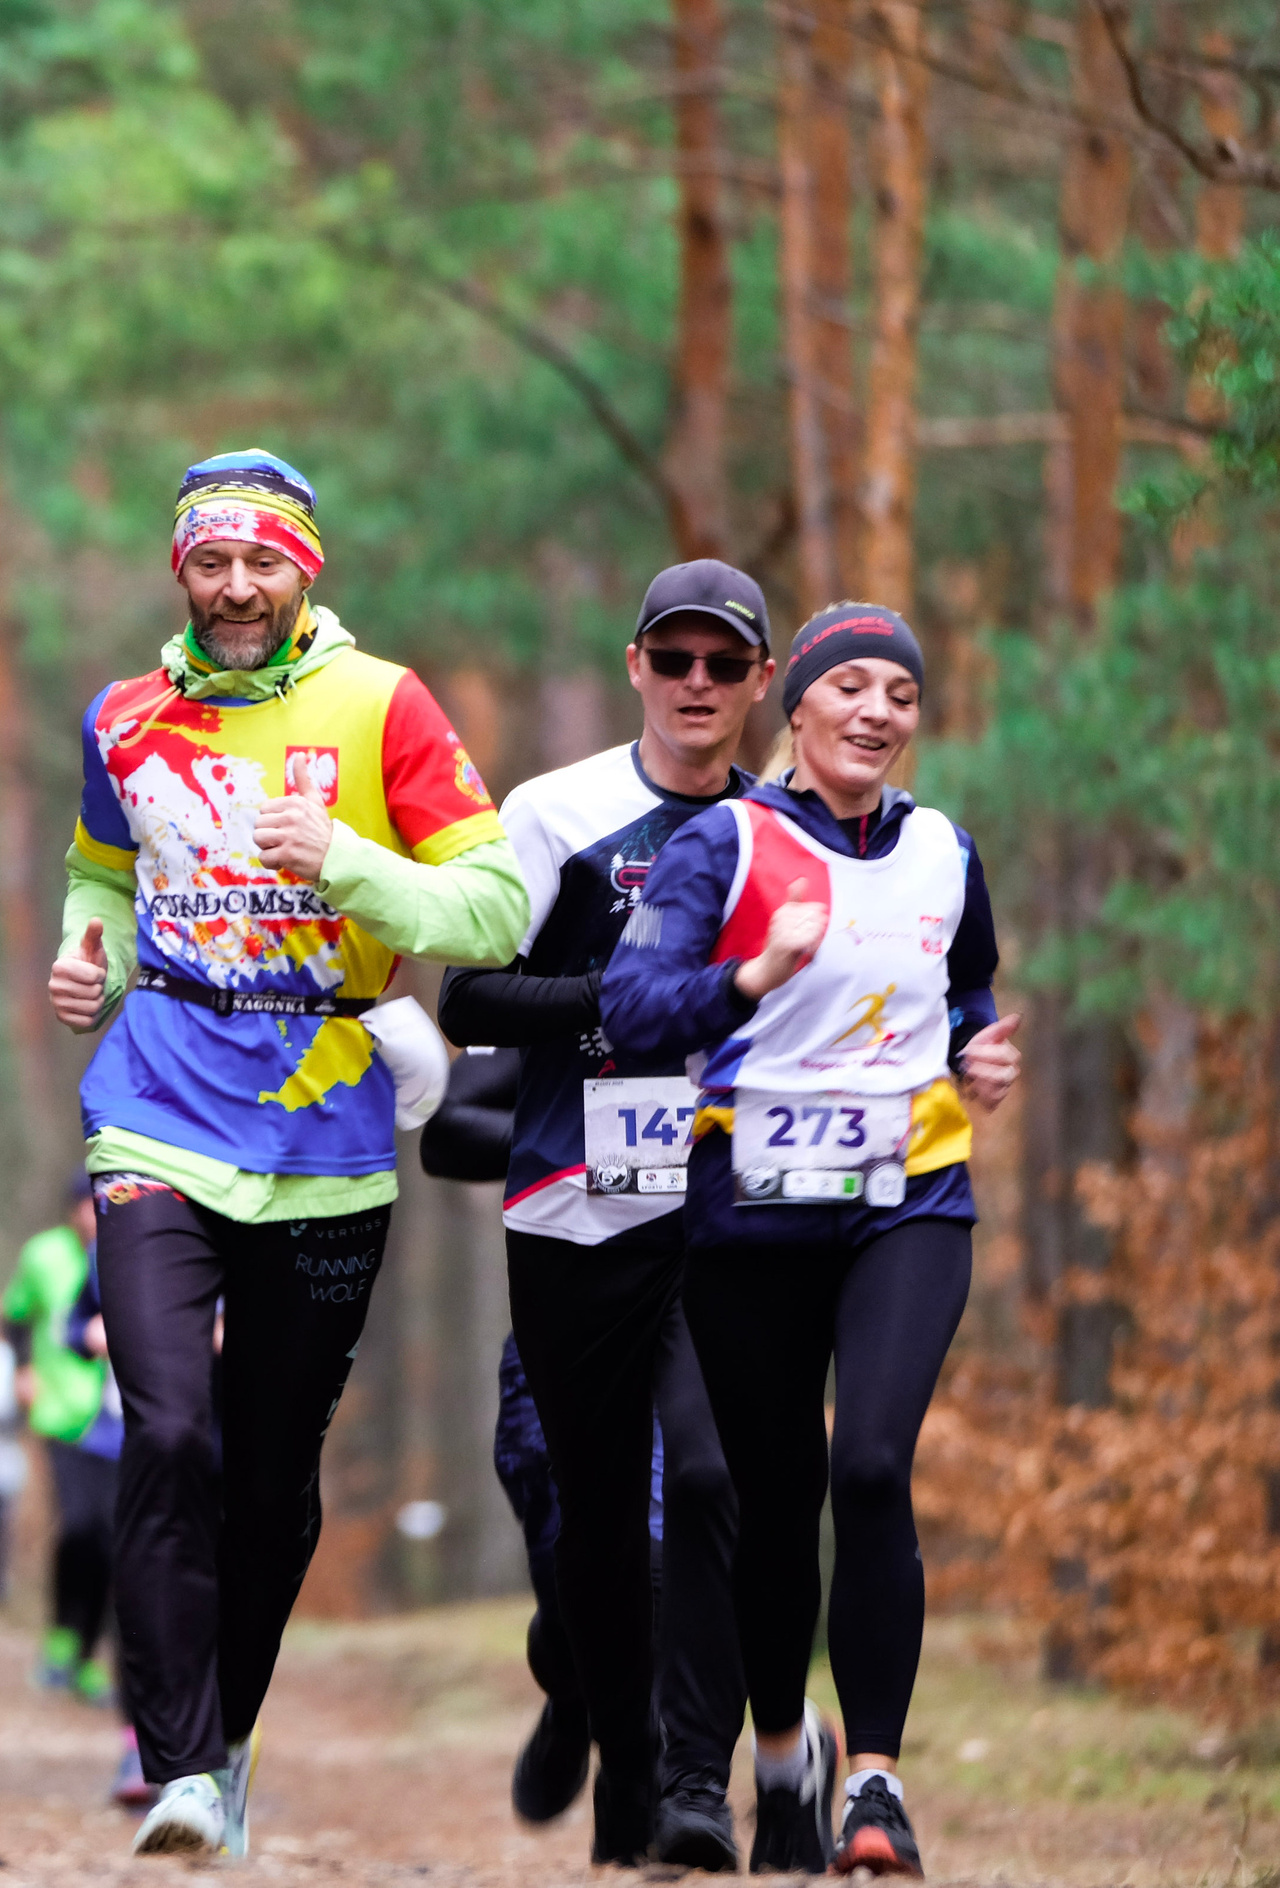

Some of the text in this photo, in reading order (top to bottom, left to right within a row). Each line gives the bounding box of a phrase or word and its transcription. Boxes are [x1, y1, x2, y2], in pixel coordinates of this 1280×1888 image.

[231, 998, 307, 1014] NAGONKA
[764, 1105, 868, 1149] 273
[314, 1218, 383, 1240] VERTISS
[295, 1248, 377, 1278] RUNNING
[310, 1278, 369, 1304] WOLF
